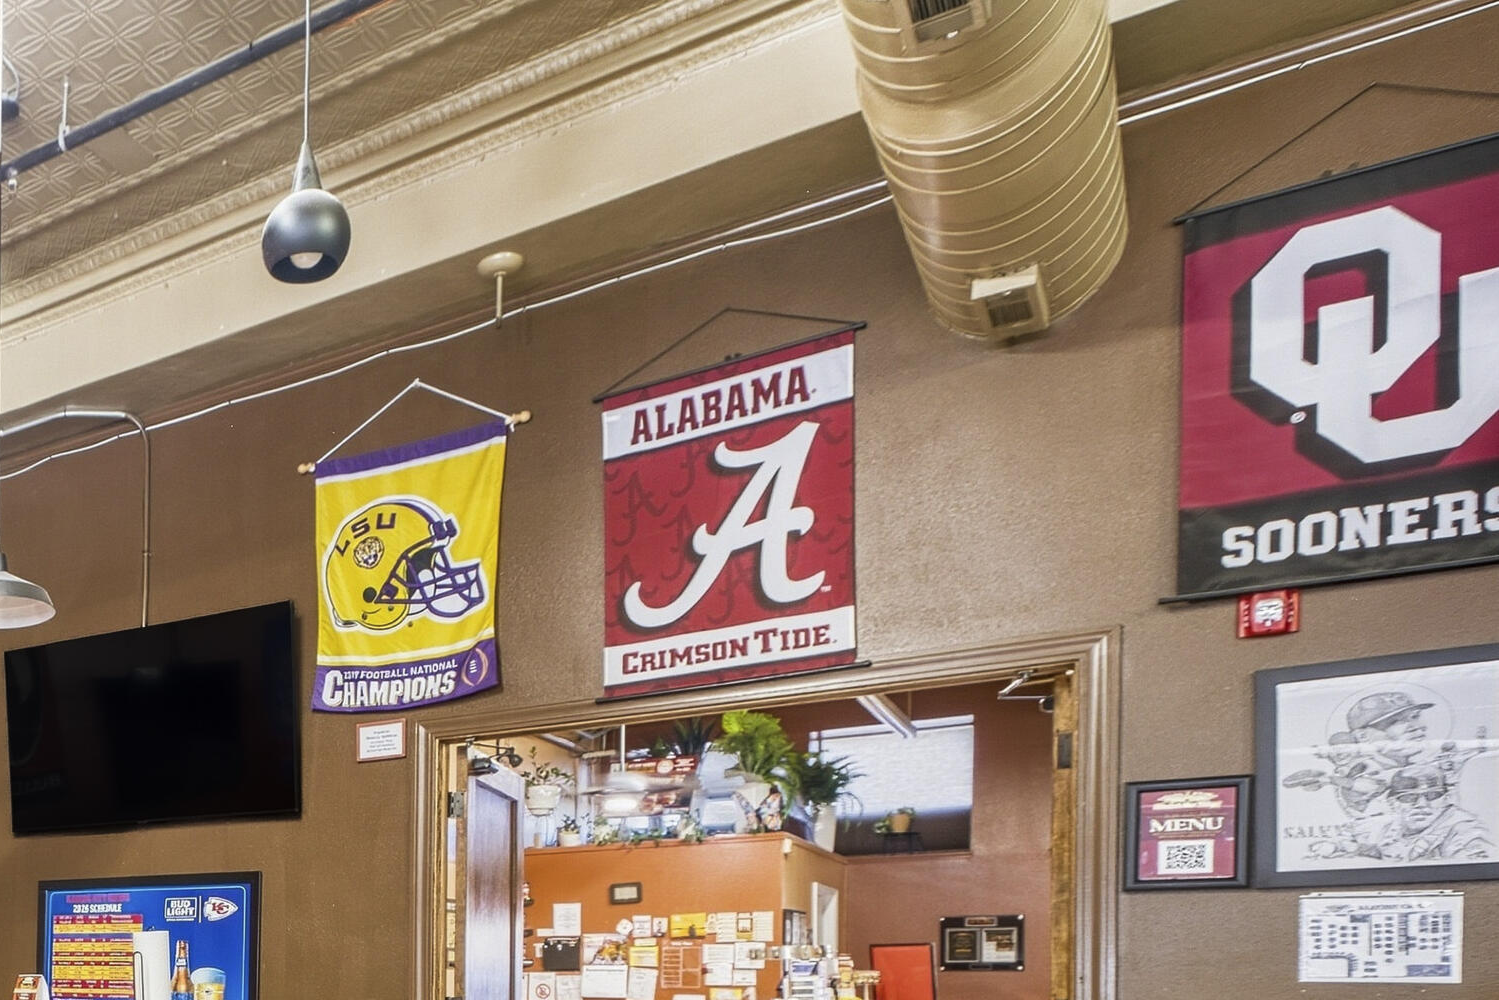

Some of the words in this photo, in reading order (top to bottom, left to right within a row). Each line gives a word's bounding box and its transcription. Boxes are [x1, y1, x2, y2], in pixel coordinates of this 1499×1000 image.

[630, 365, 811, 446] ALABAMA
[335, 511, 397, 558] LSU
[621, 634, 751, 676] CRIMSON
[753, 624, 832, 653] TIDE
[360, 667, 409, 680] FOOTBALL
[410, 659, 459, 676] NATIONAL
[321, 669, 457, 708] CHAMPIONS
[1148, 816, 1225, 833] MENU
[89, 903, 123, 913] SCHEDULE
[166, 907, 195, 916] LIGHT
[170, 899, 191, 908] BUD
